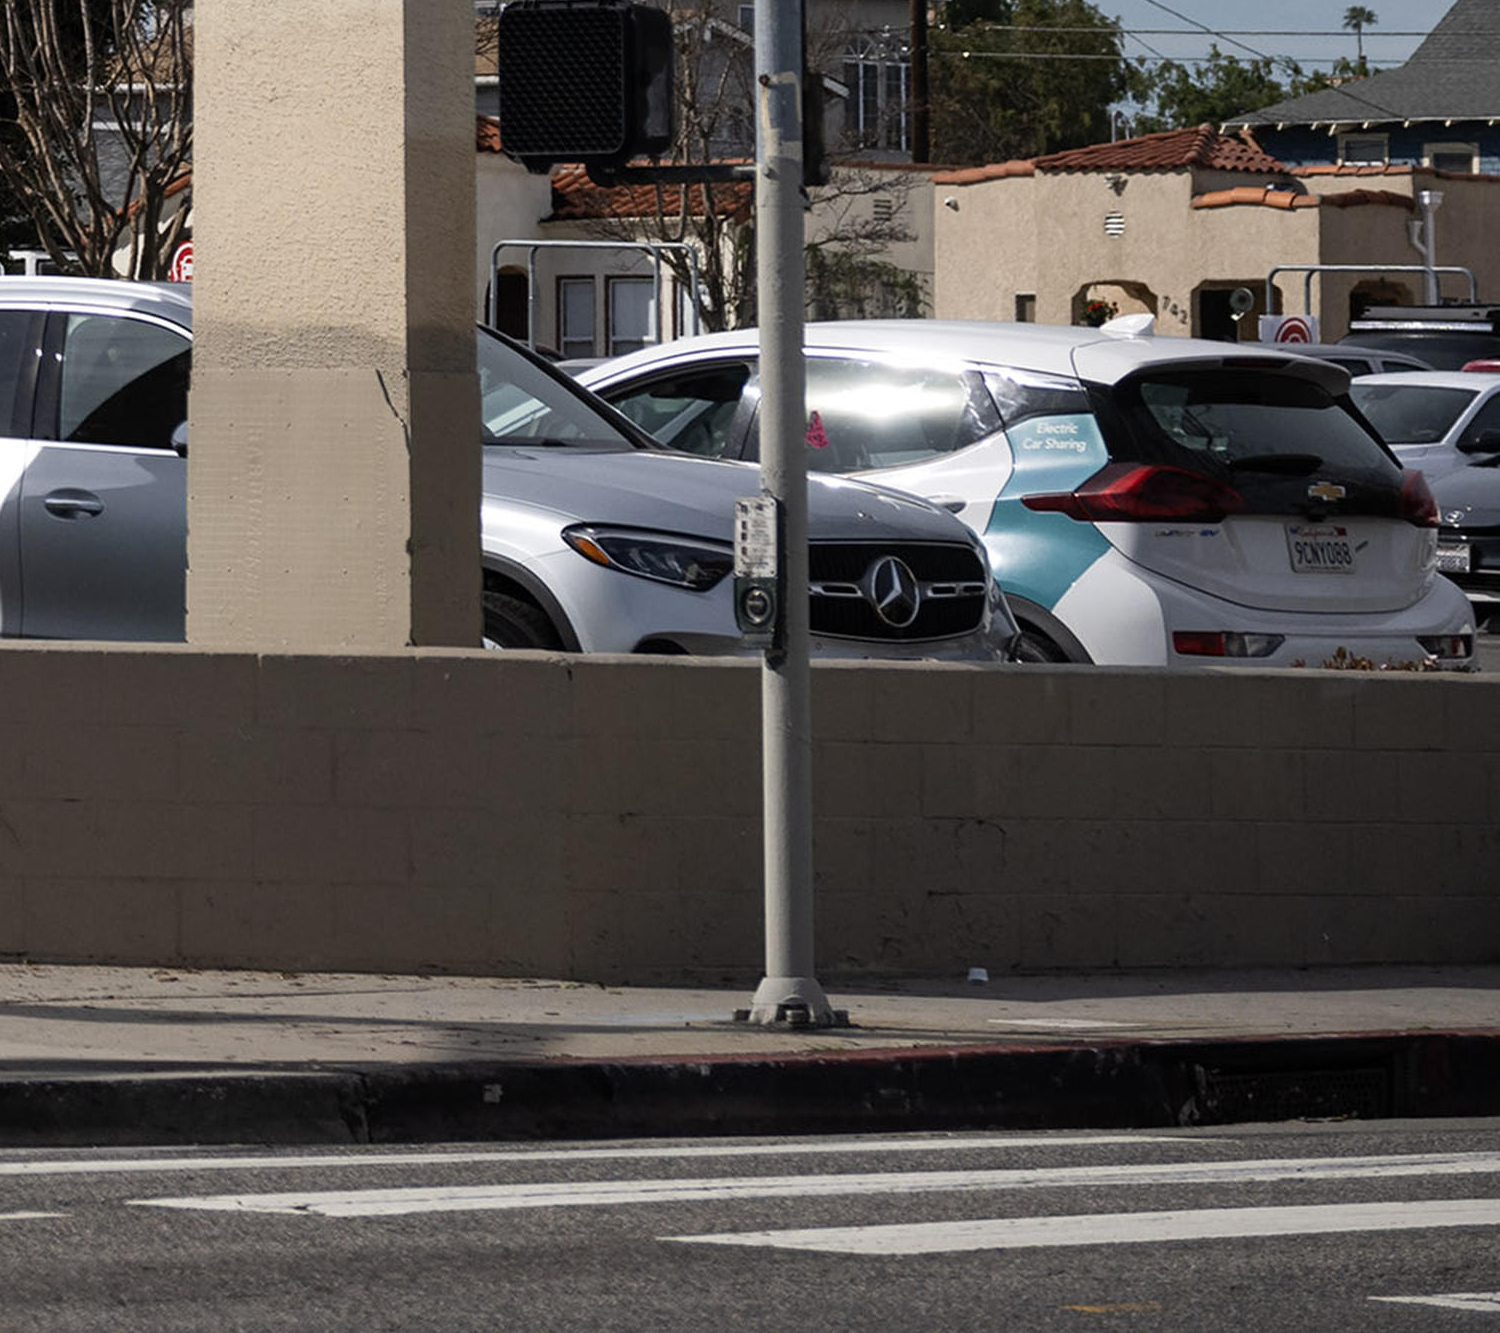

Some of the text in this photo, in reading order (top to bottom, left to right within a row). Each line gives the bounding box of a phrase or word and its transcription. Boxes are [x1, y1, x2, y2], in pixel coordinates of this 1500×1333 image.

[1036, 422, 1079, 434] Electric
[1023, 437, 1086, 453] Car Sharing
[1295, 540, 1351, 566] 9CNY088
